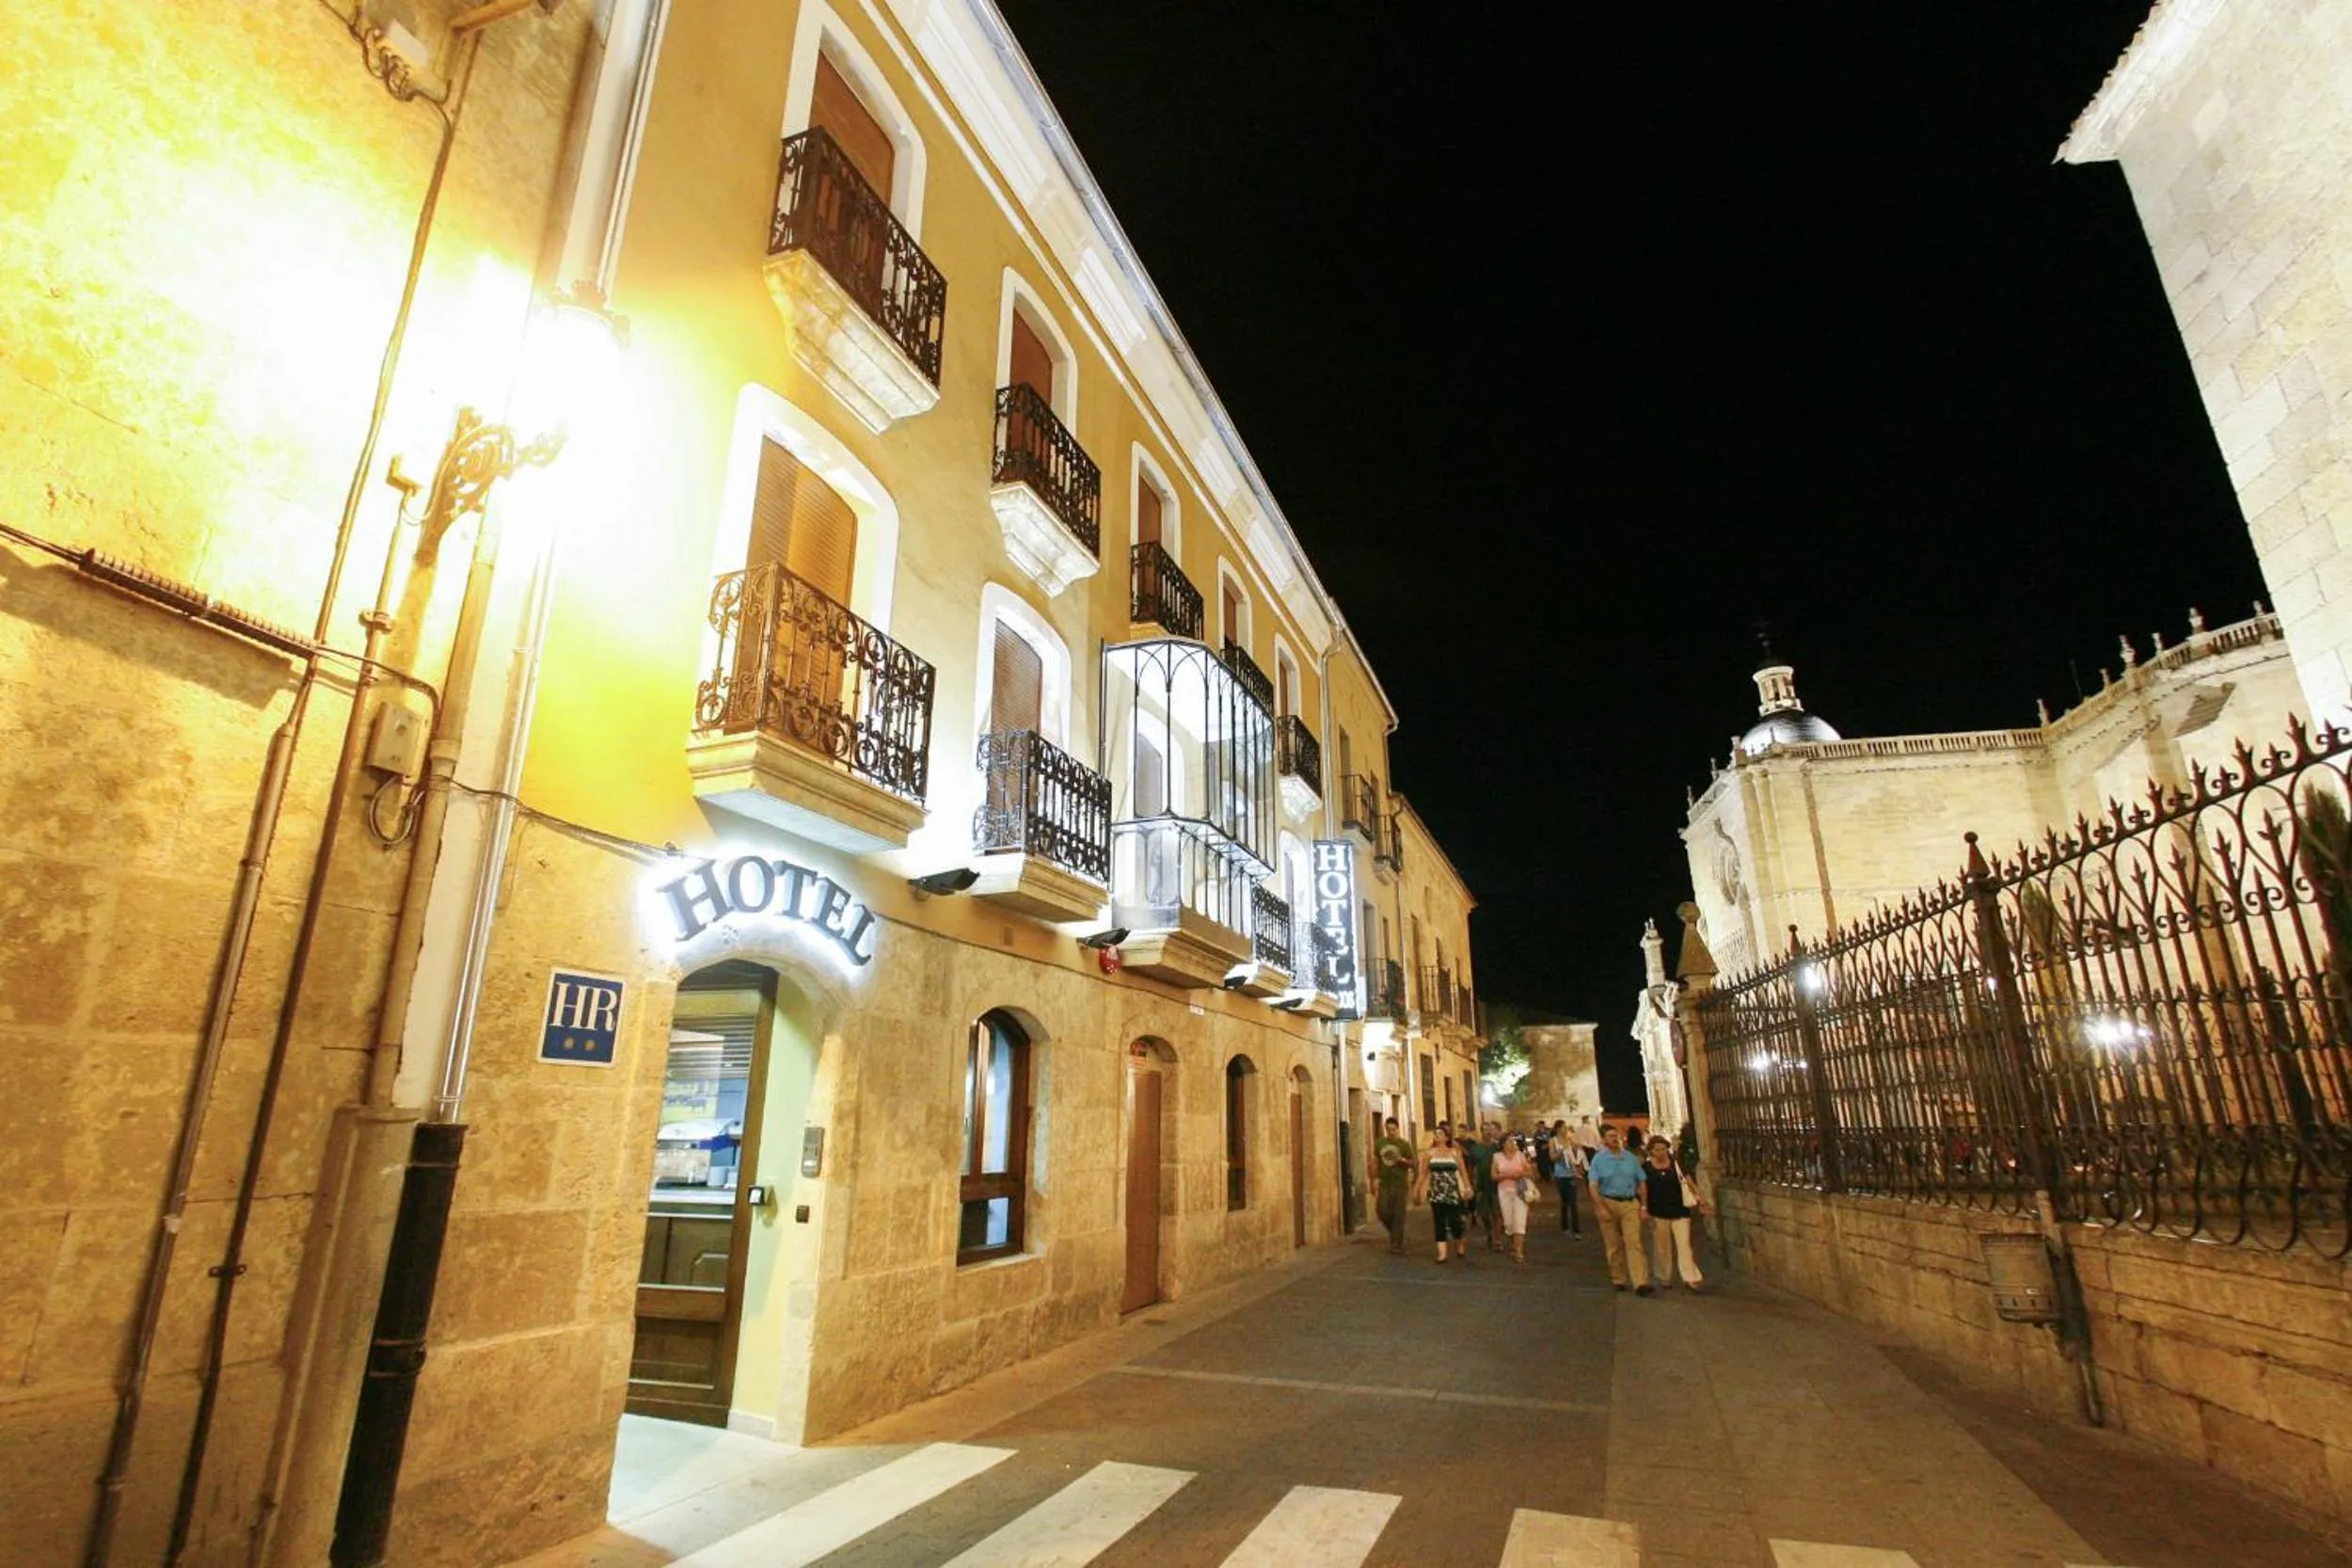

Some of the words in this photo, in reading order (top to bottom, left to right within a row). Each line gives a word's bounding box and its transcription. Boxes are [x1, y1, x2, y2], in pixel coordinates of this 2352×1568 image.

[657, 855, 877, 967] HOTEL
[1317, 844, 1351, 984] HOTEL
[549, 981, 618, 1033] HR
